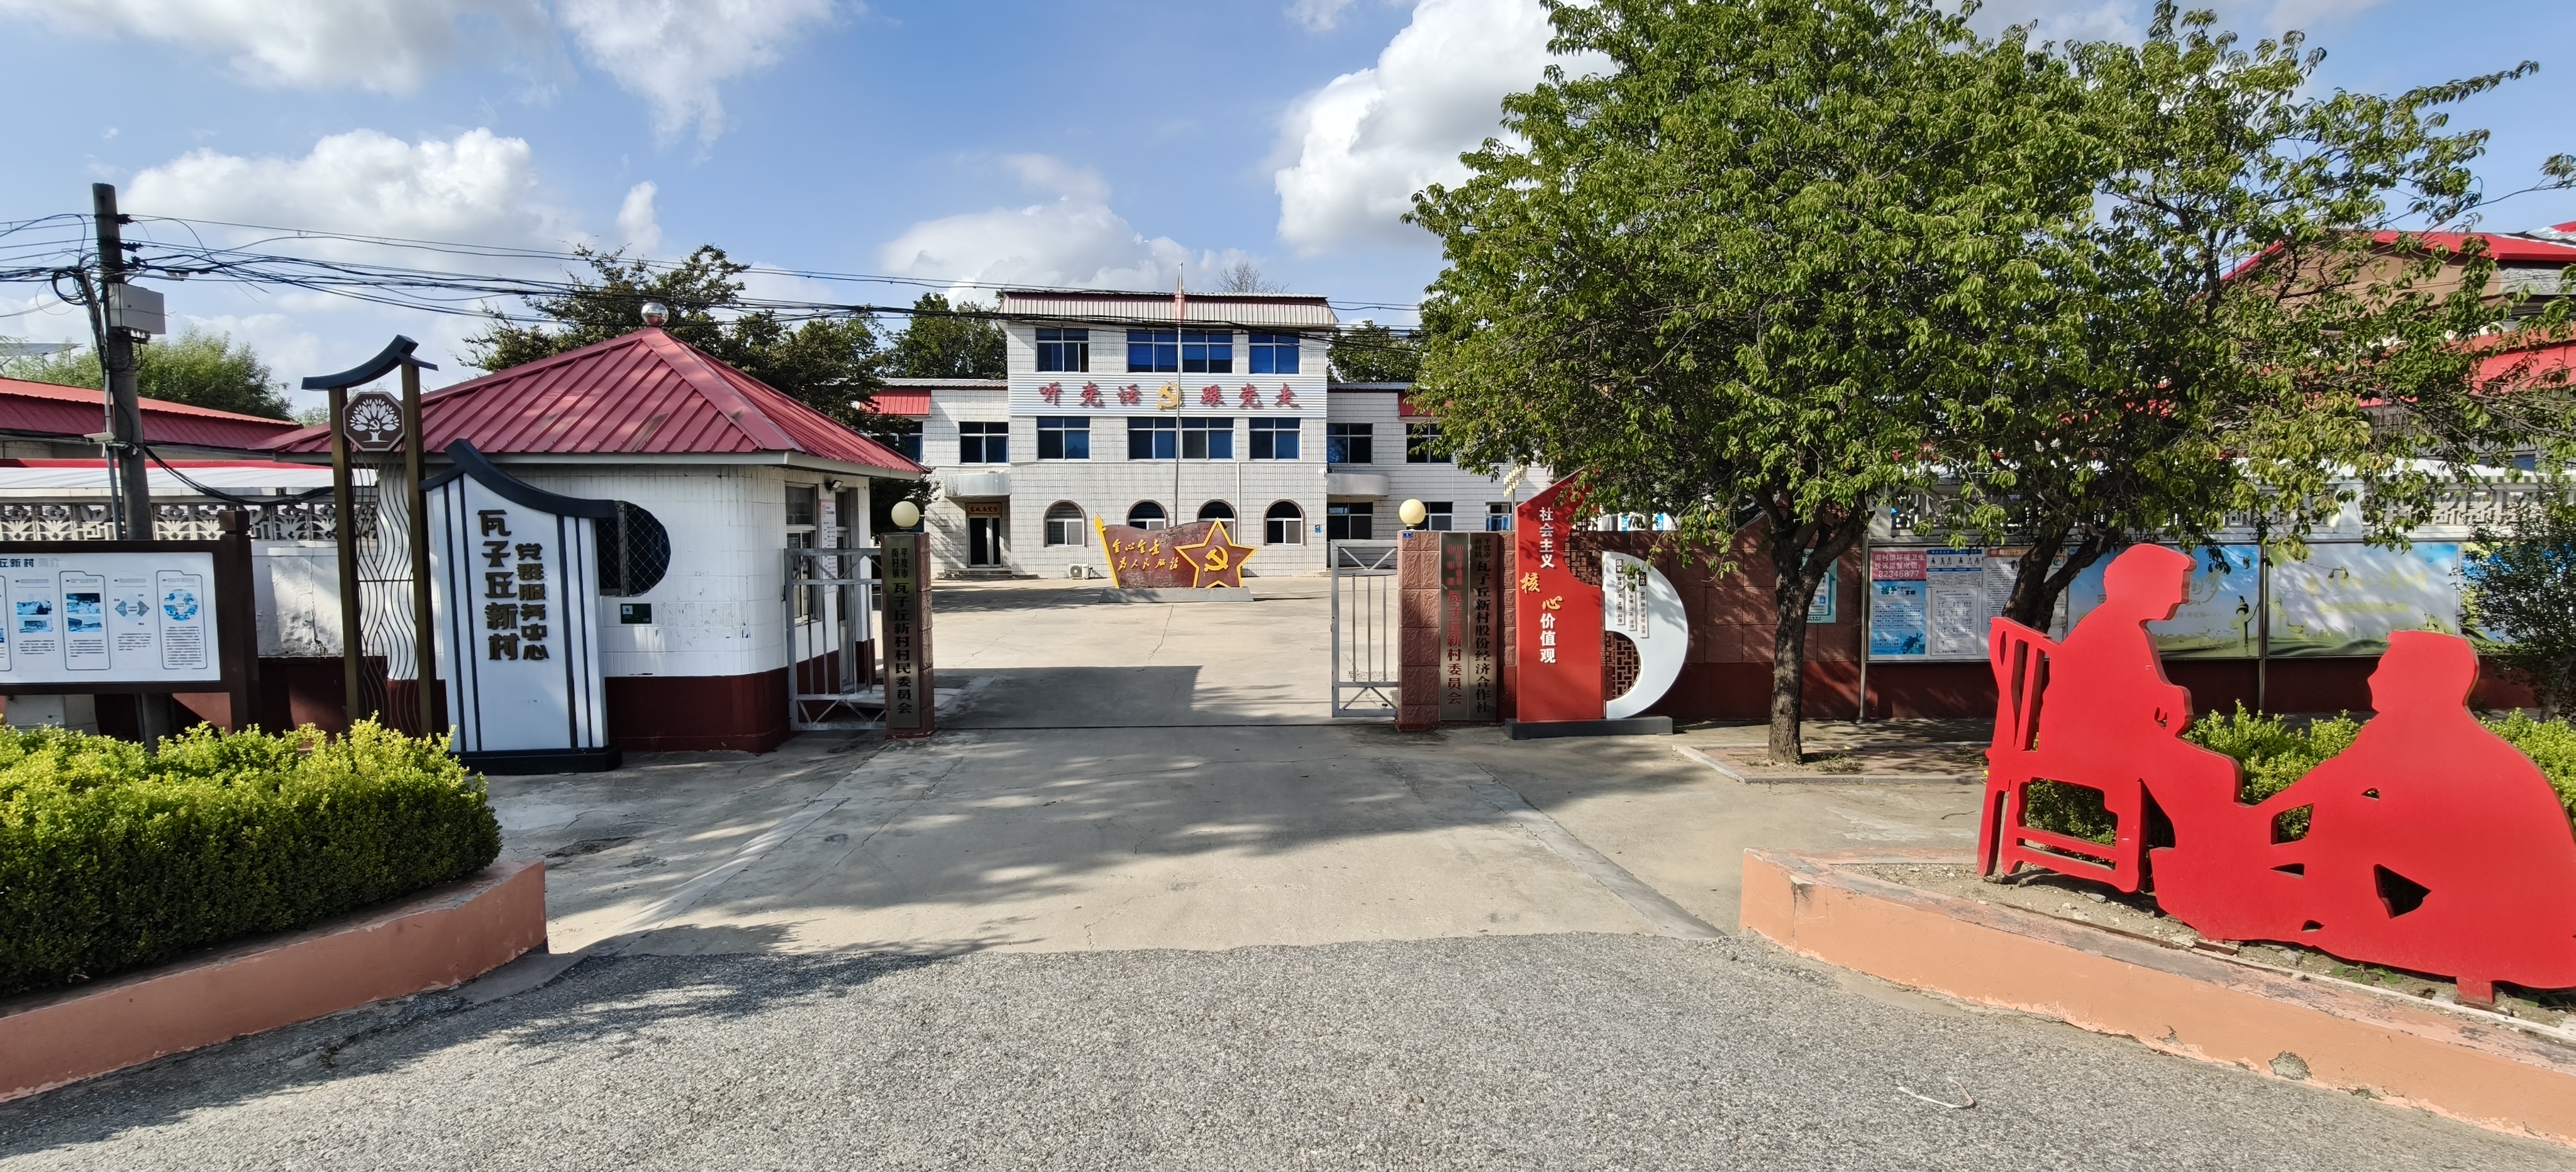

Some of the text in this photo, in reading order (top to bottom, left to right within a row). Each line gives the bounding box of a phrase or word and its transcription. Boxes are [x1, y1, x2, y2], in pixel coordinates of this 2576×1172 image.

[1039, 381, 1302, 409] 听党话 跟党走
[892, 548, 900, 578] 南村镇
[901, 548, 909, 578] 平度市
[1112, 539, 1160, 556] 全心全意
[1540, 507, 1555, 569] 社会主义
[1616, 560, 1622, 572] 国家
[477, 510, 520, 660] 瓦子丘新村
[515, 543, 550, 660] 党群服务中心
[892, 582, 913, 714] 瓦子丘新村村民委员会
[1447, 590, 1462, 705] 瓦子丘新村委员会
[1475, 560, 1491, 713] 瓦子丘新村股份经济合作社
[1540, 613, 1556, 663] 价值观
